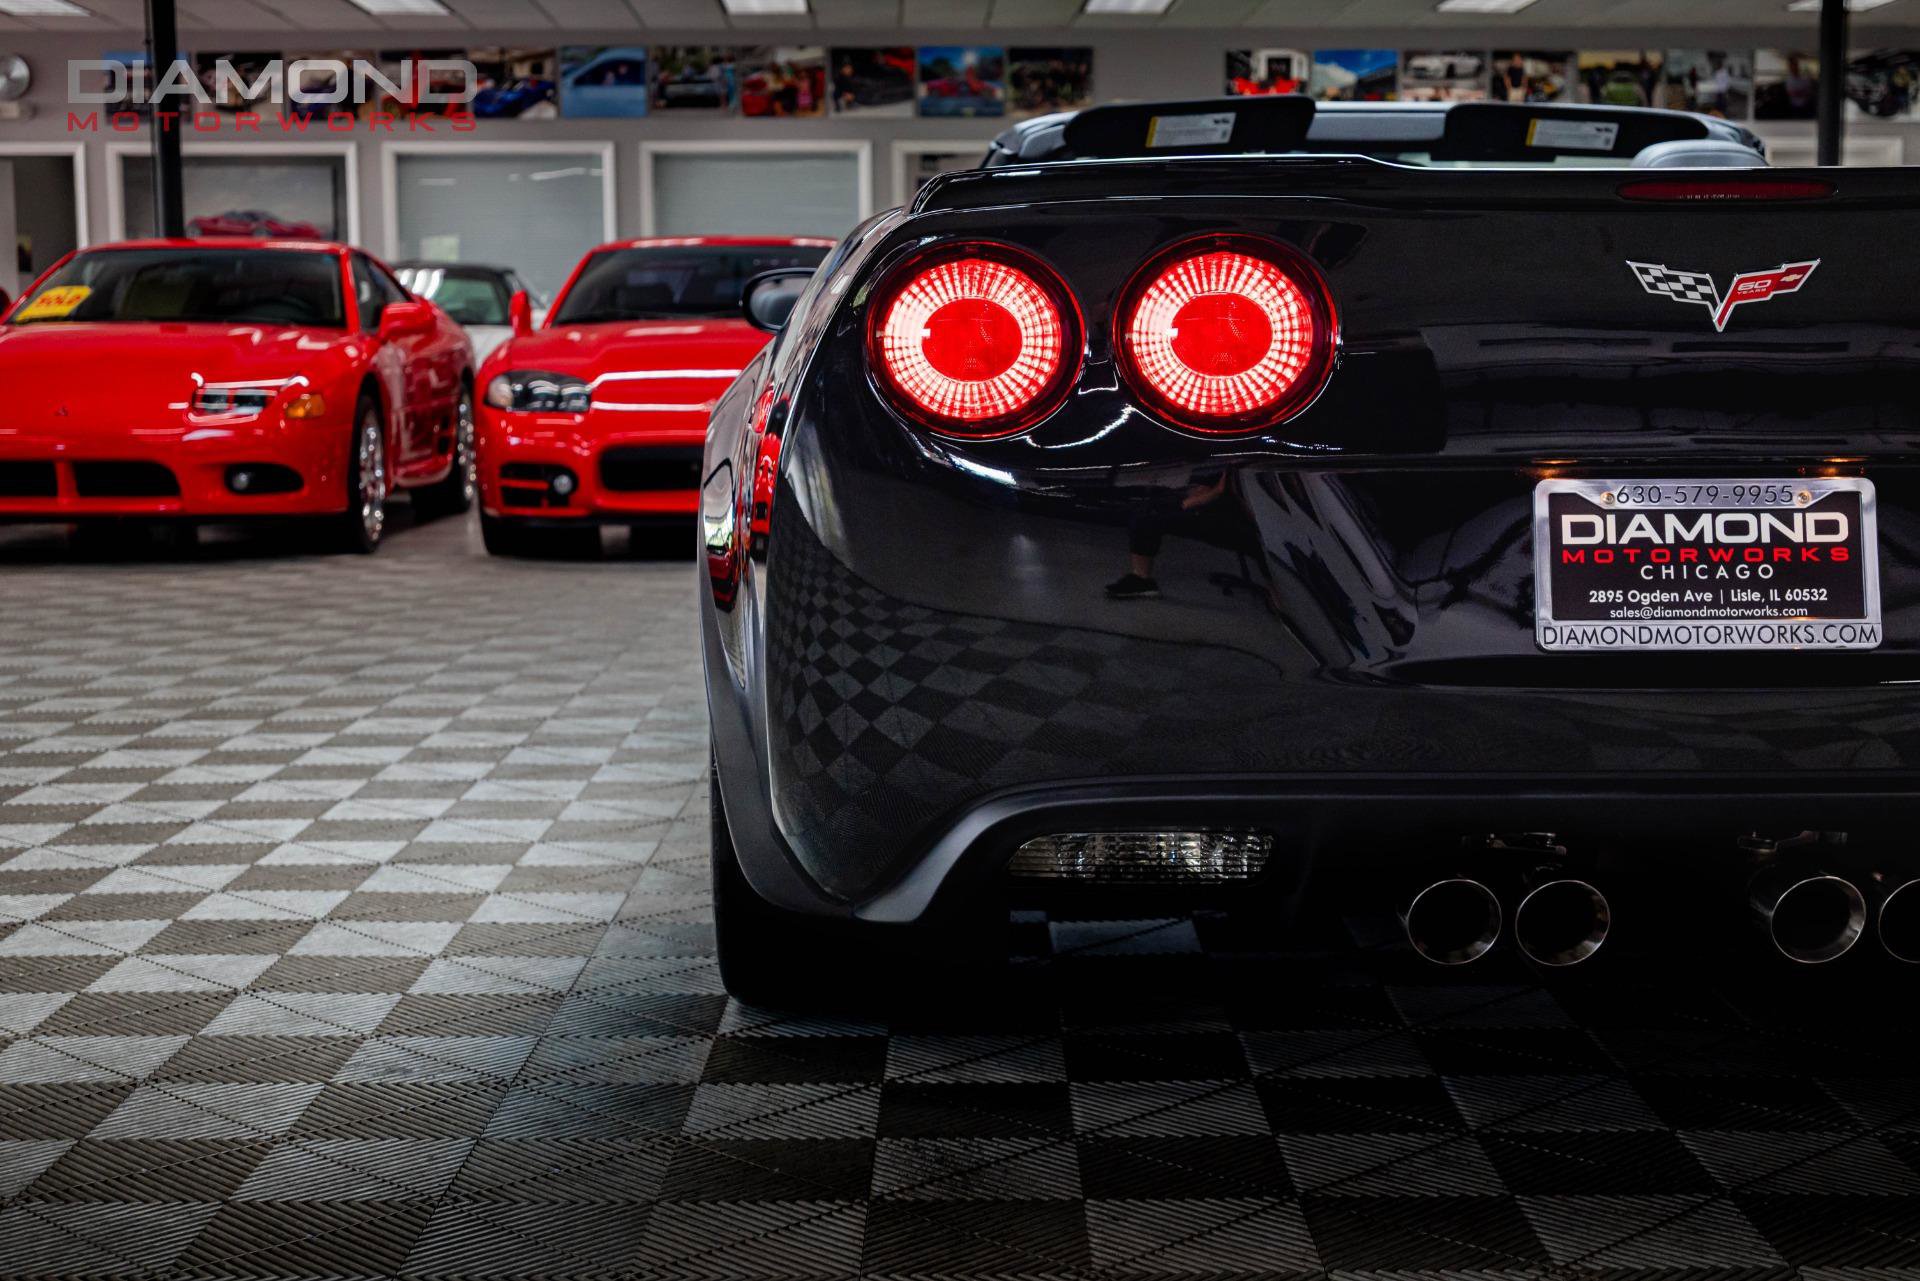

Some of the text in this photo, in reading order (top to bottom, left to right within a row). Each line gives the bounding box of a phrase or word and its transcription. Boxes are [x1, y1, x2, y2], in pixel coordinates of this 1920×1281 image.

[1738, 280, 1771, 291] 60
[1616, 485, 1793, 504] 630-579-9955
[1561, 512, 1849, 545] DIAMOND
[1562, 547, 1849, 564] MOTORWORKS
[1640, 564, 1774, 580] CHICAGO
[1589, 588, 1828, 606] 2895 Ogden Ave Lisle, IL 60532
[1610, 604, 1808, 619] sales@diamondmotorworks.com
[1543, 624, 1878, 645] DIAMONDMOTORWORKS.COM
